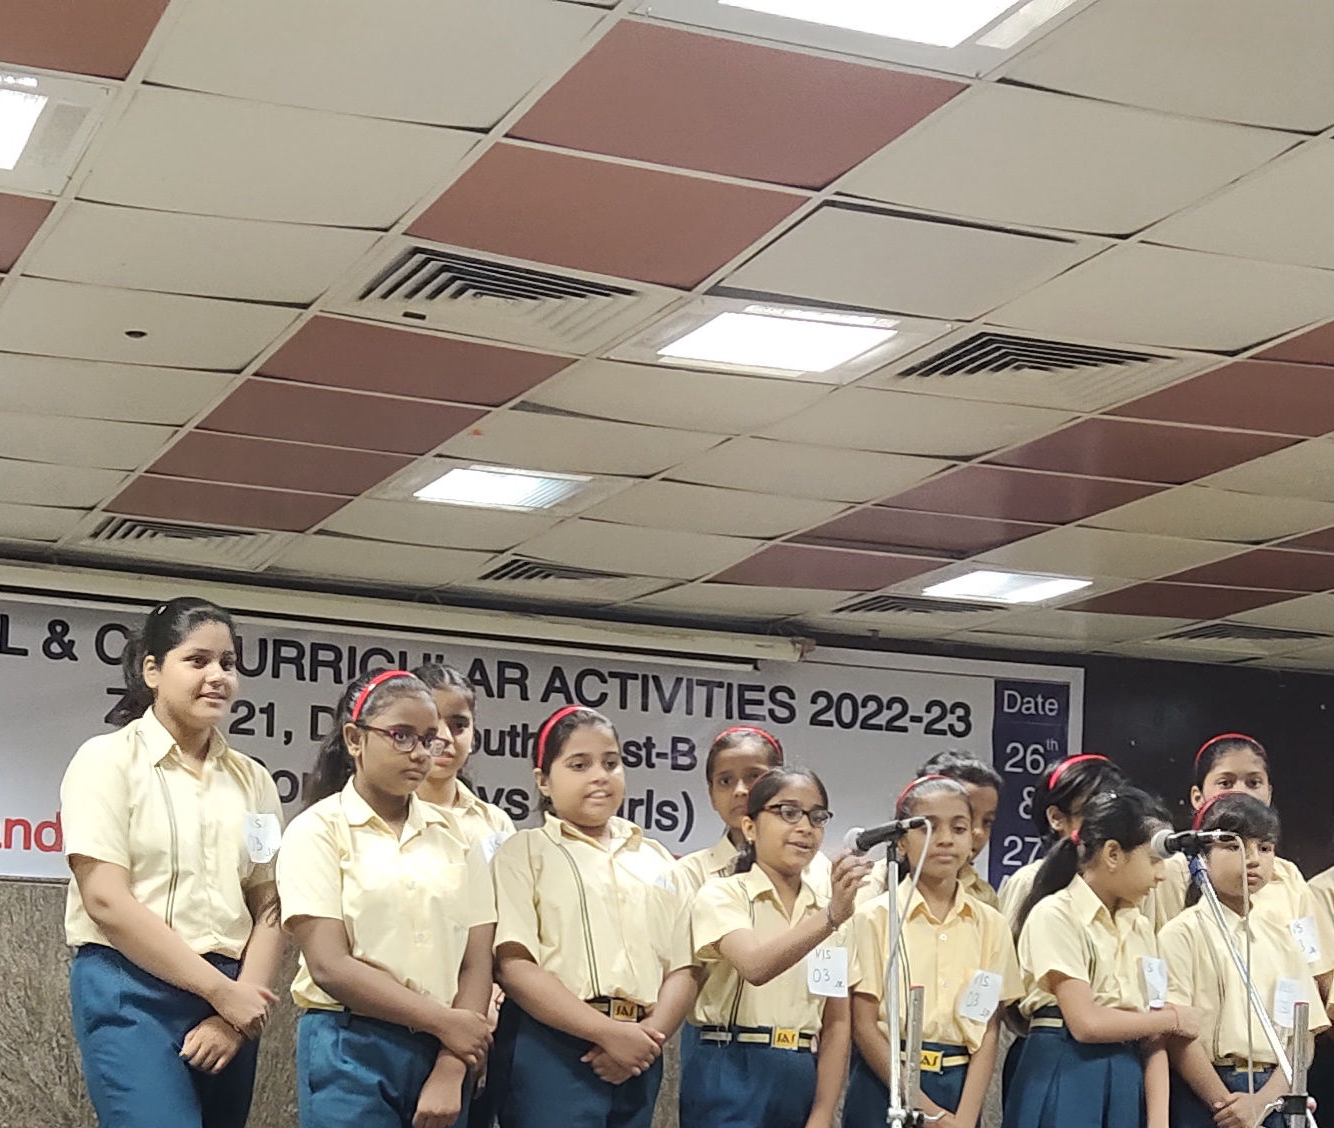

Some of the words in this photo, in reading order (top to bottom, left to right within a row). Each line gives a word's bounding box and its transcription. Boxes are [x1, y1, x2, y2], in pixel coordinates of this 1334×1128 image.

[41, 618, 79, 661] &
[540, 665, 796, 725] ACTIVITIES
[809, 690, 972, 738] 2022-23
[1003, 689, 1059, 716] Date
[622, 736, 697, 771] st-B
